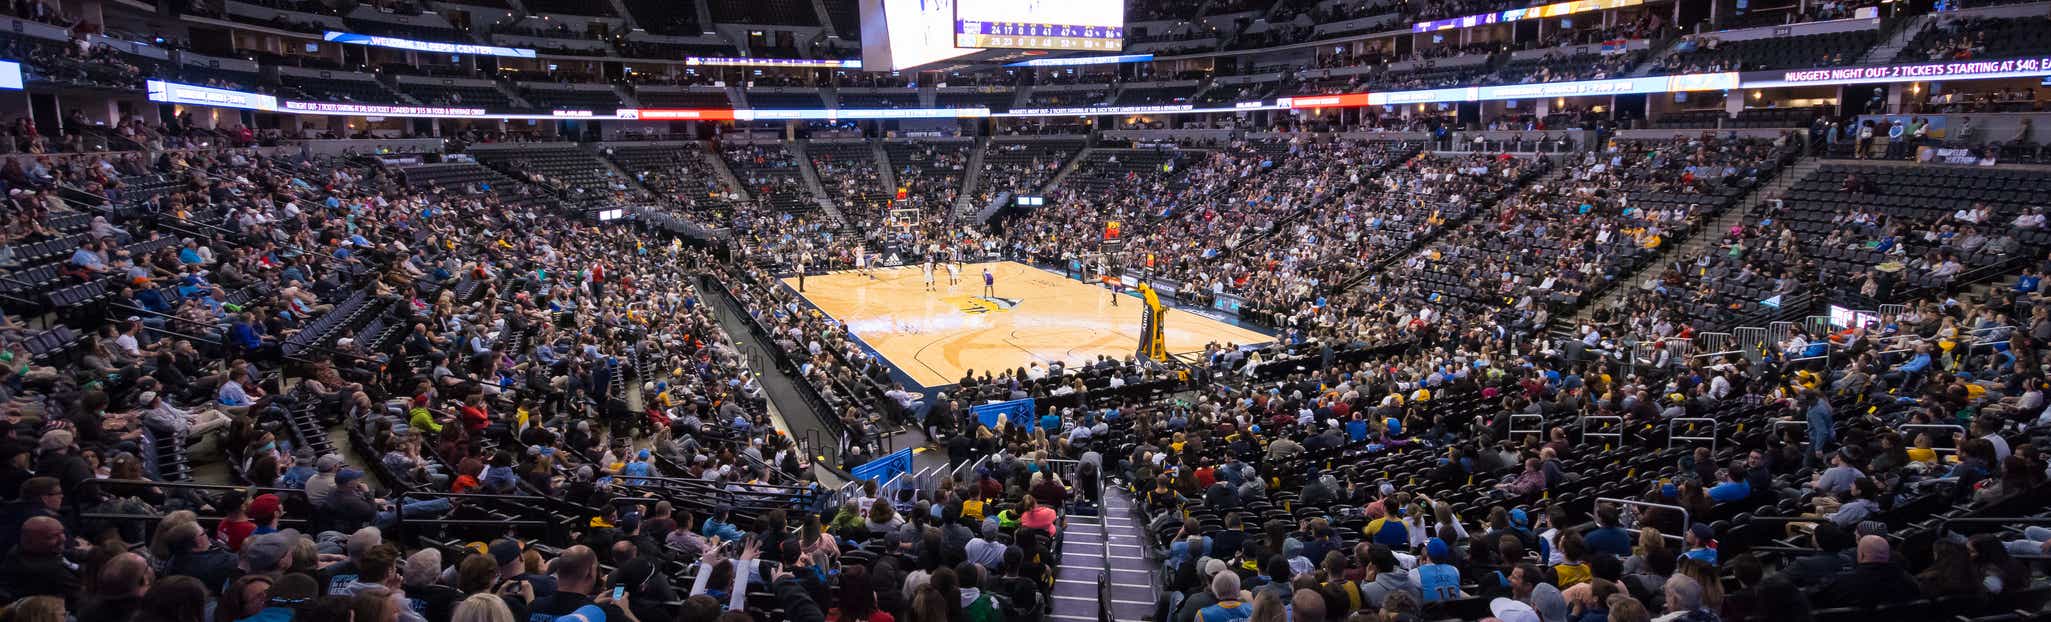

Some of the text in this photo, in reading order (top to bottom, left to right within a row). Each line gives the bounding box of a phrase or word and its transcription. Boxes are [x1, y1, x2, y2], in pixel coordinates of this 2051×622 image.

[991, 26, 1001, 34] 24
[1004, 26, 1013, 35] 17
[1018, 27, 1024, 35] 0
[1031, 27, 1036, 36] 0
[1042, 28, 1052, 36] 41
[457, 45, 493, 56] CENTER
[1785, 70, 1830, 81] NUGGETS
[1832, 68, 1863, 79] NIGHT
[1865, 67, 1890, 78] OUT-
[1892, 66, 1900, 76] 2
[1902, 65, 1944, 76] TICKETS
[1947, 62, 1999, 73] STARTING
[2000, 60, 2014, 71] AT
[2016, 60, 2038, 71] $40;
[1434, 586, 1457, 599] 15
